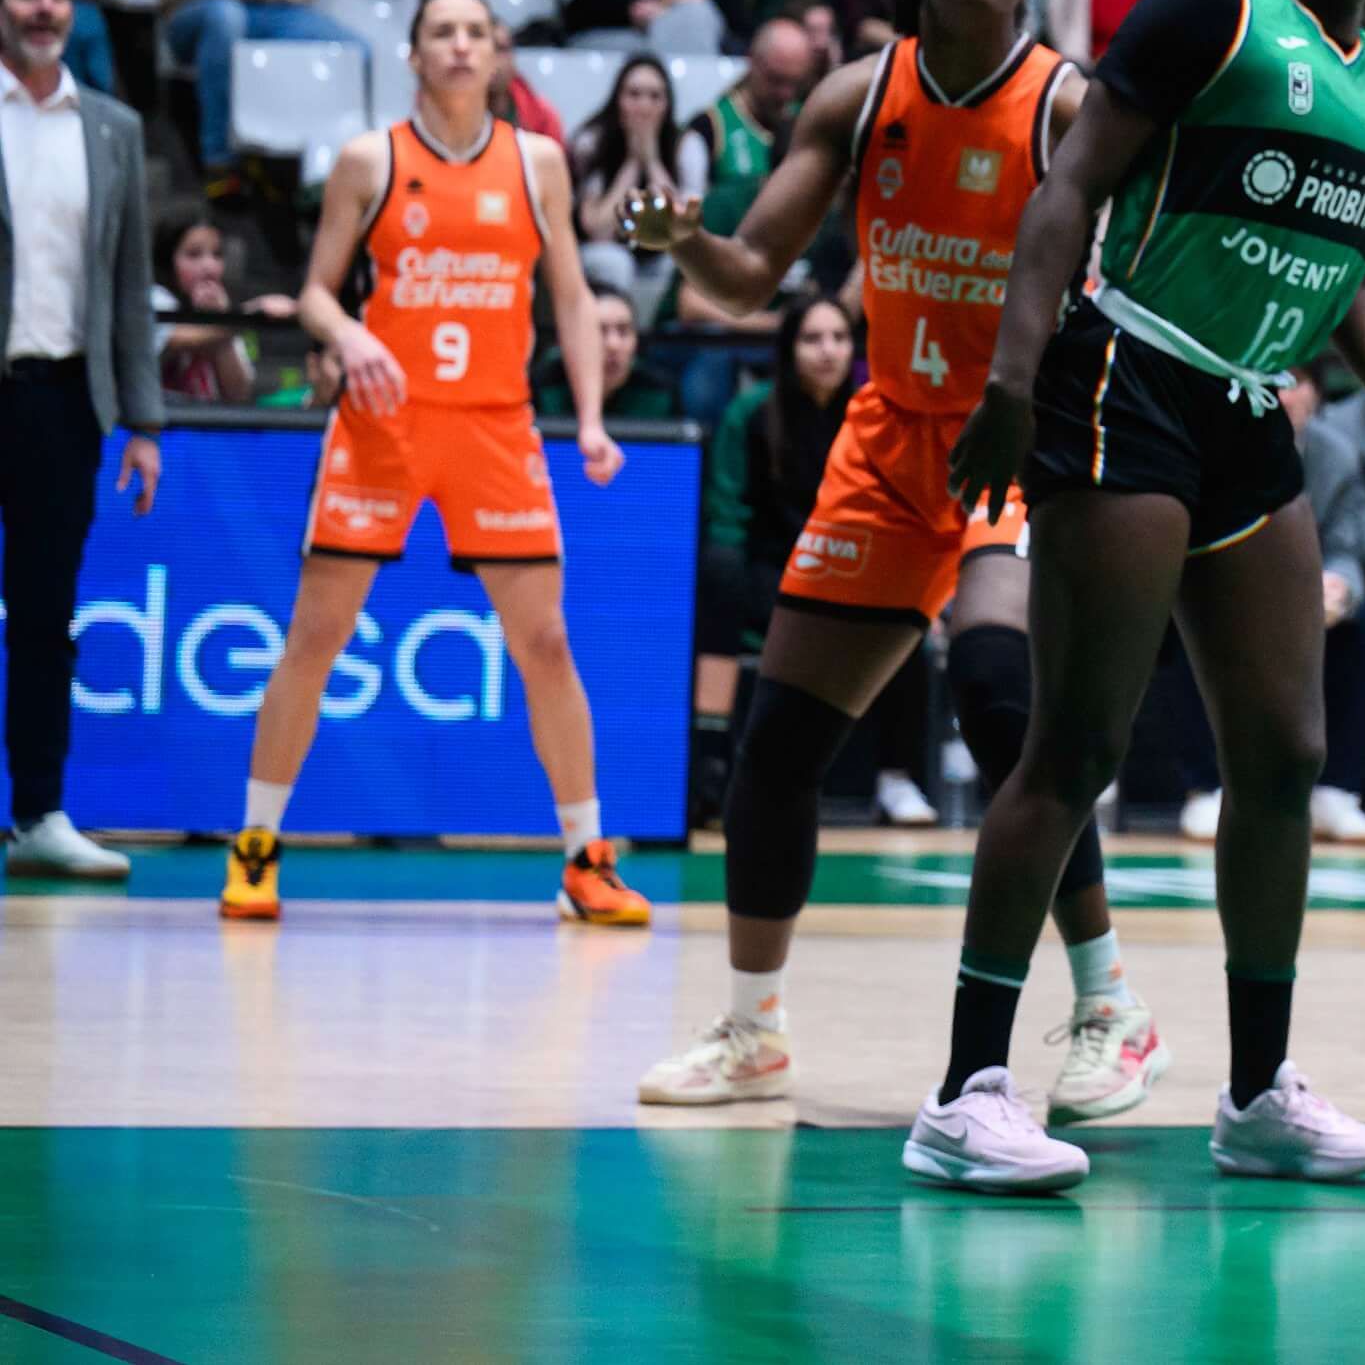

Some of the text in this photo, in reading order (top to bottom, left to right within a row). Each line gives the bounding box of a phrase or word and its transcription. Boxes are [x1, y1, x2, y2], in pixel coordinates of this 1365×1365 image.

[868, 217, 980, 266] Cultura
[432, 321, 470, 382] 9
[911, 316, 950, 387] 4
